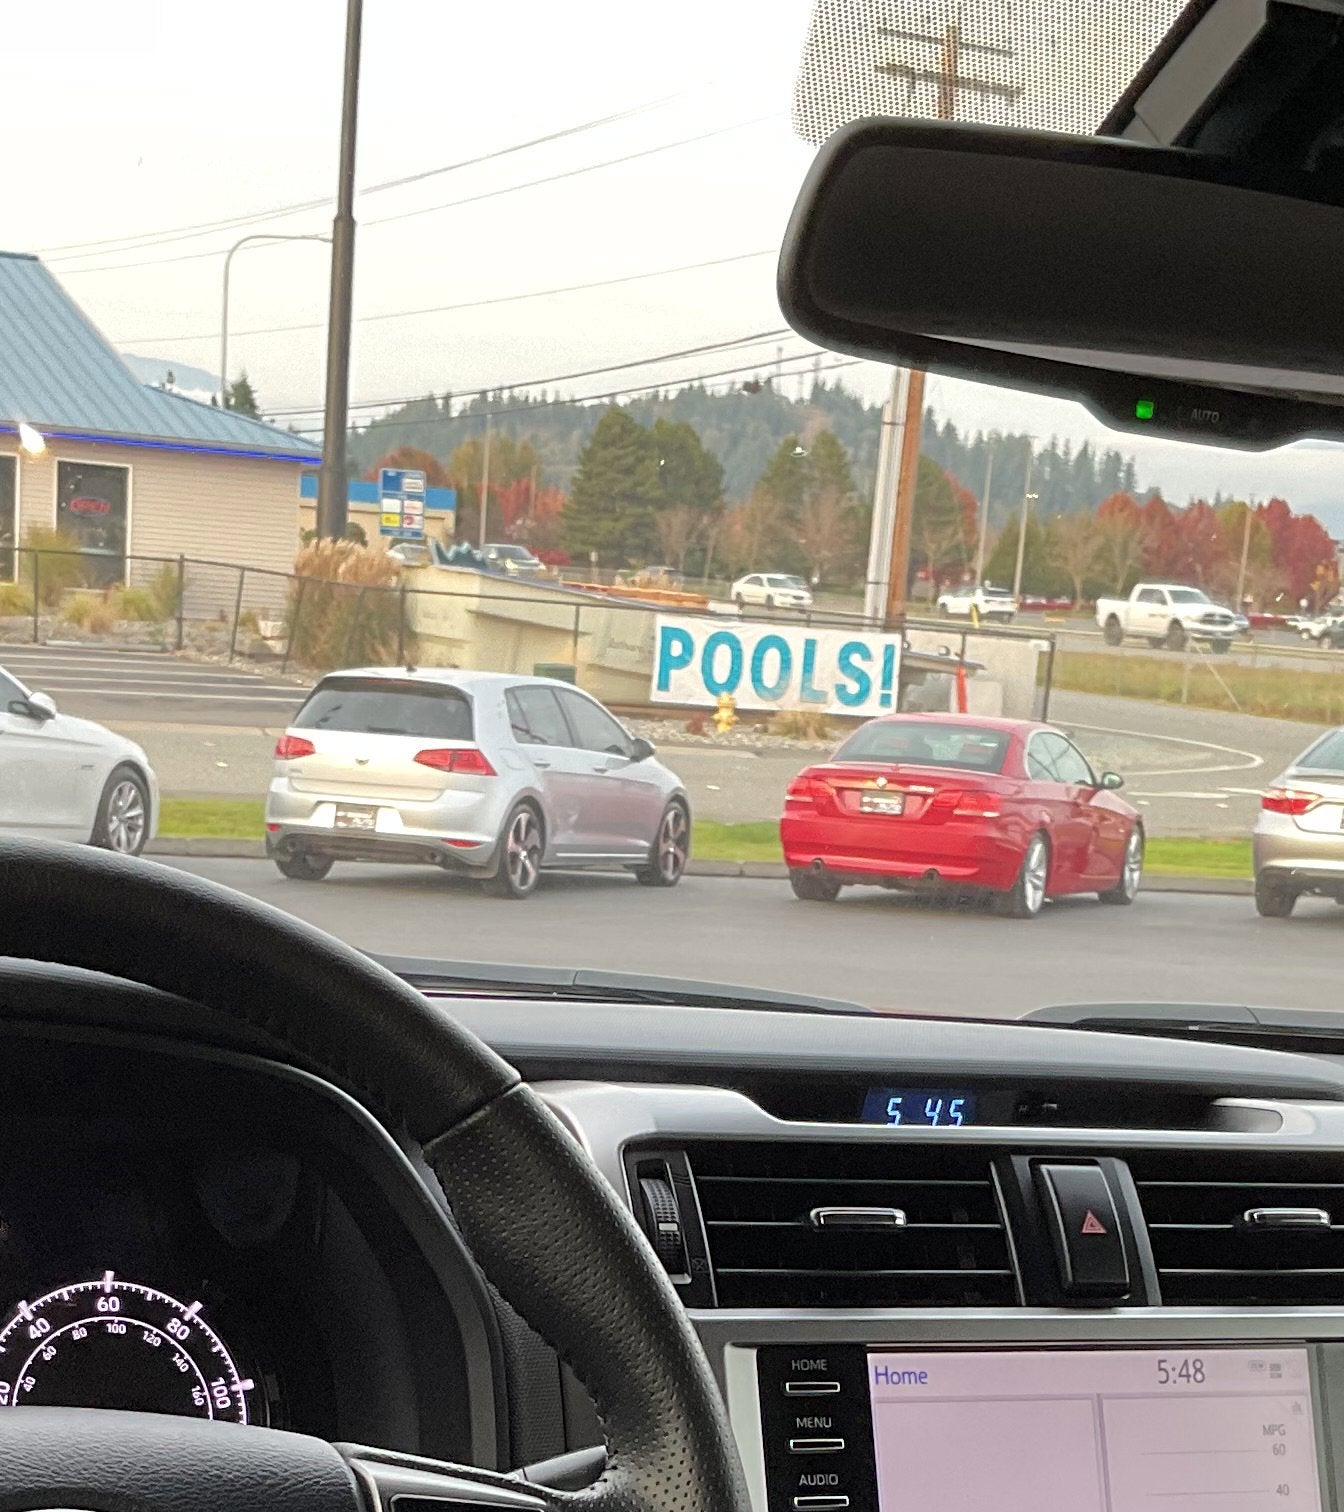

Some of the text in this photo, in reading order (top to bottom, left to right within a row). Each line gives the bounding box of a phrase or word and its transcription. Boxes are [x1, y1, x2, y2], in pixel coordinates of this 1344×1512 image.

[1190, 408, 1220, 424] AUTO
[657, 626, 896, 708] POOLS!
[97, 1296, 120, 1313] 60
[27, 1317, 52, 1340] 40
[72, 1327, 88, 1341] 80
[106, 1322, 127, 1335] 100
[165, 1317, 191, 1341] 80
[142, 1330, 162, 1347] 120
[42, 1346, 57, 1361] 60
[171, 1352, 190, 1373] 140
[791, 1359, 828, 1371] HOME
[874, 1358, 1206, 1386] Home 5:48
[23, 1375, 37, 1392] 40
[191, 1385, 205, 1407] 160
[210, 1377, 231, 1409] 100
[796, 1416, 832, 1429] MENU
[1262, 1424, 1286, 1436] MPG
[1272, 1442, 1286, 1456] 60
[798, 1473, 839, 1486] AUDIO
[1276, 1483, 1290, 1496] 40
